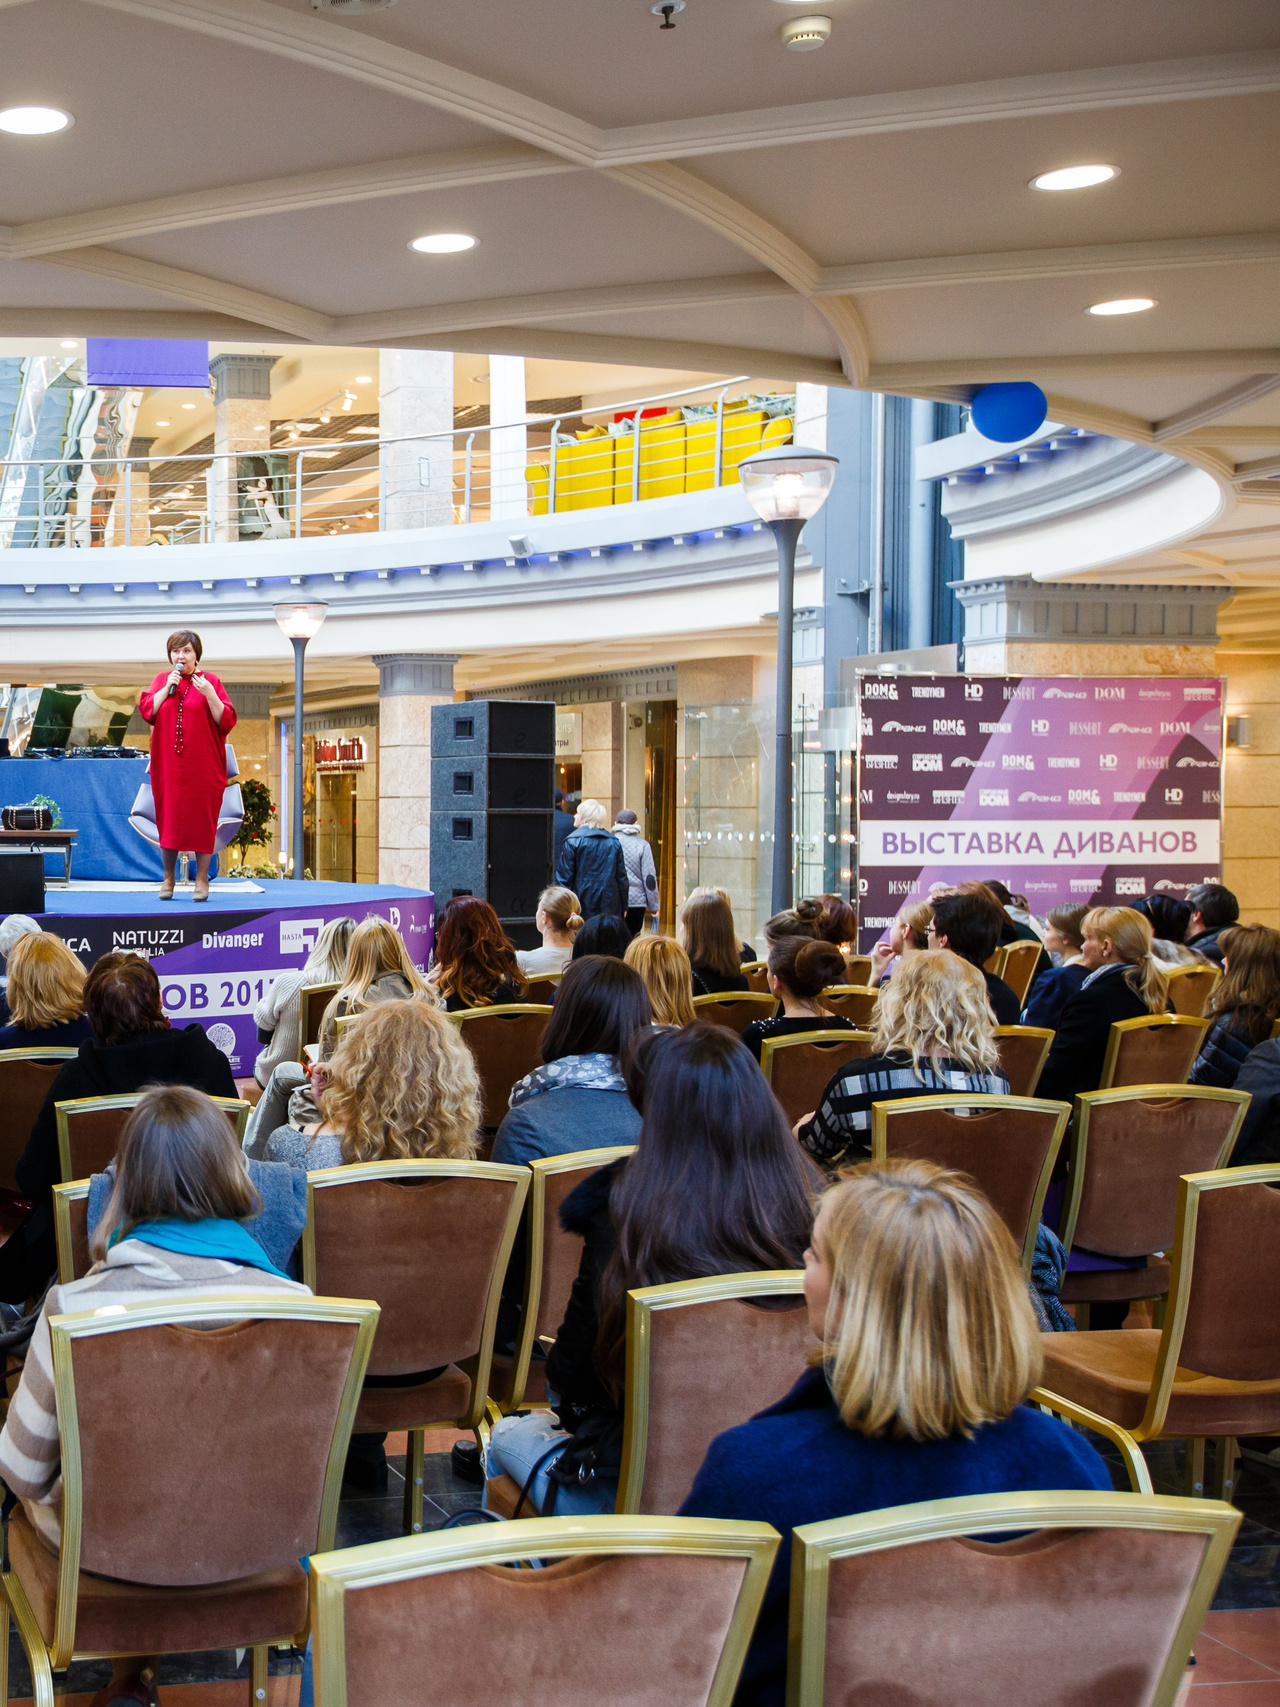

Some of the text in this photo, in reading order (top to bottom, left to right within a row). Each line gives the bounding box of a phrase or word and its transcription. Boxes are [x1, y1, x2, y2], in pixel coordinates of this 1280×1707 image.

[881, 831, 1197, 859] ВЫСТАВКА ДИВАНОВ
[112, 930, 184, 945] NATUZZI
[202, 932, 264, 949] Divanger
[161, 983, 209, 1010] ОВ
